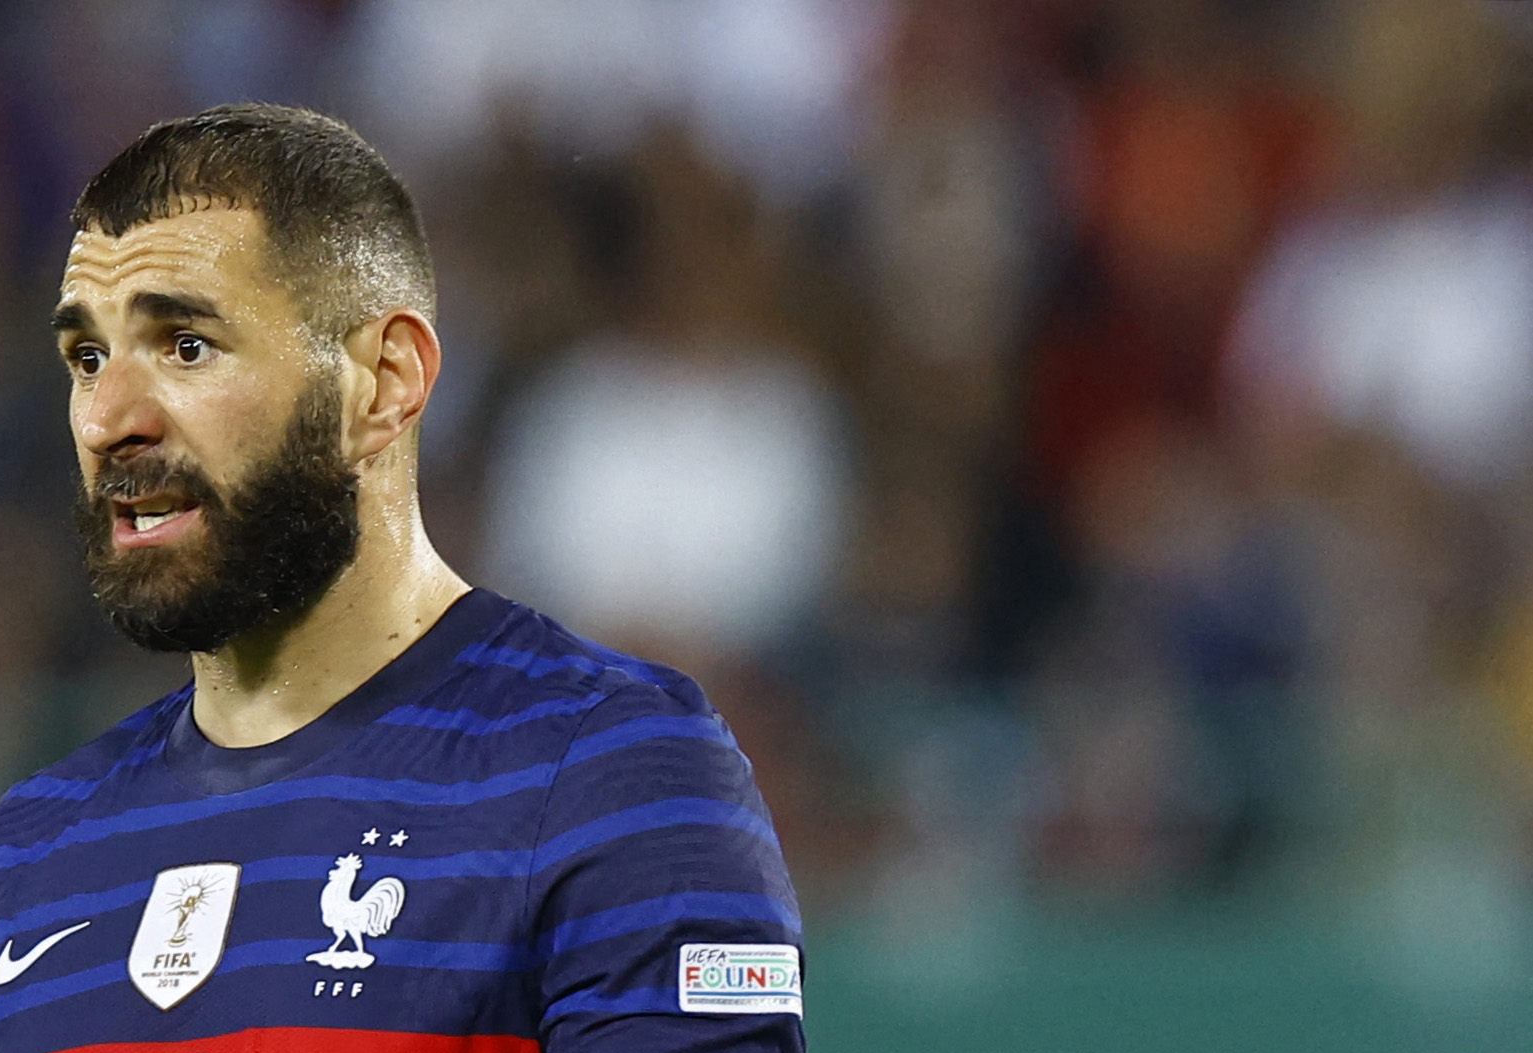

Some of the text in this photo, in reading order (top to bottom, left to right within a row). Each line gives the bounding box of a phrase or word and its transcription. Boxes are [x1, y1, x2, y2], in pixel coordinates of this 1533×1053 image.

[153, 952, 191, 969] FIFA
[686, 949, 727, 963] UEFA
[157, 979, 179, 988] 2018
